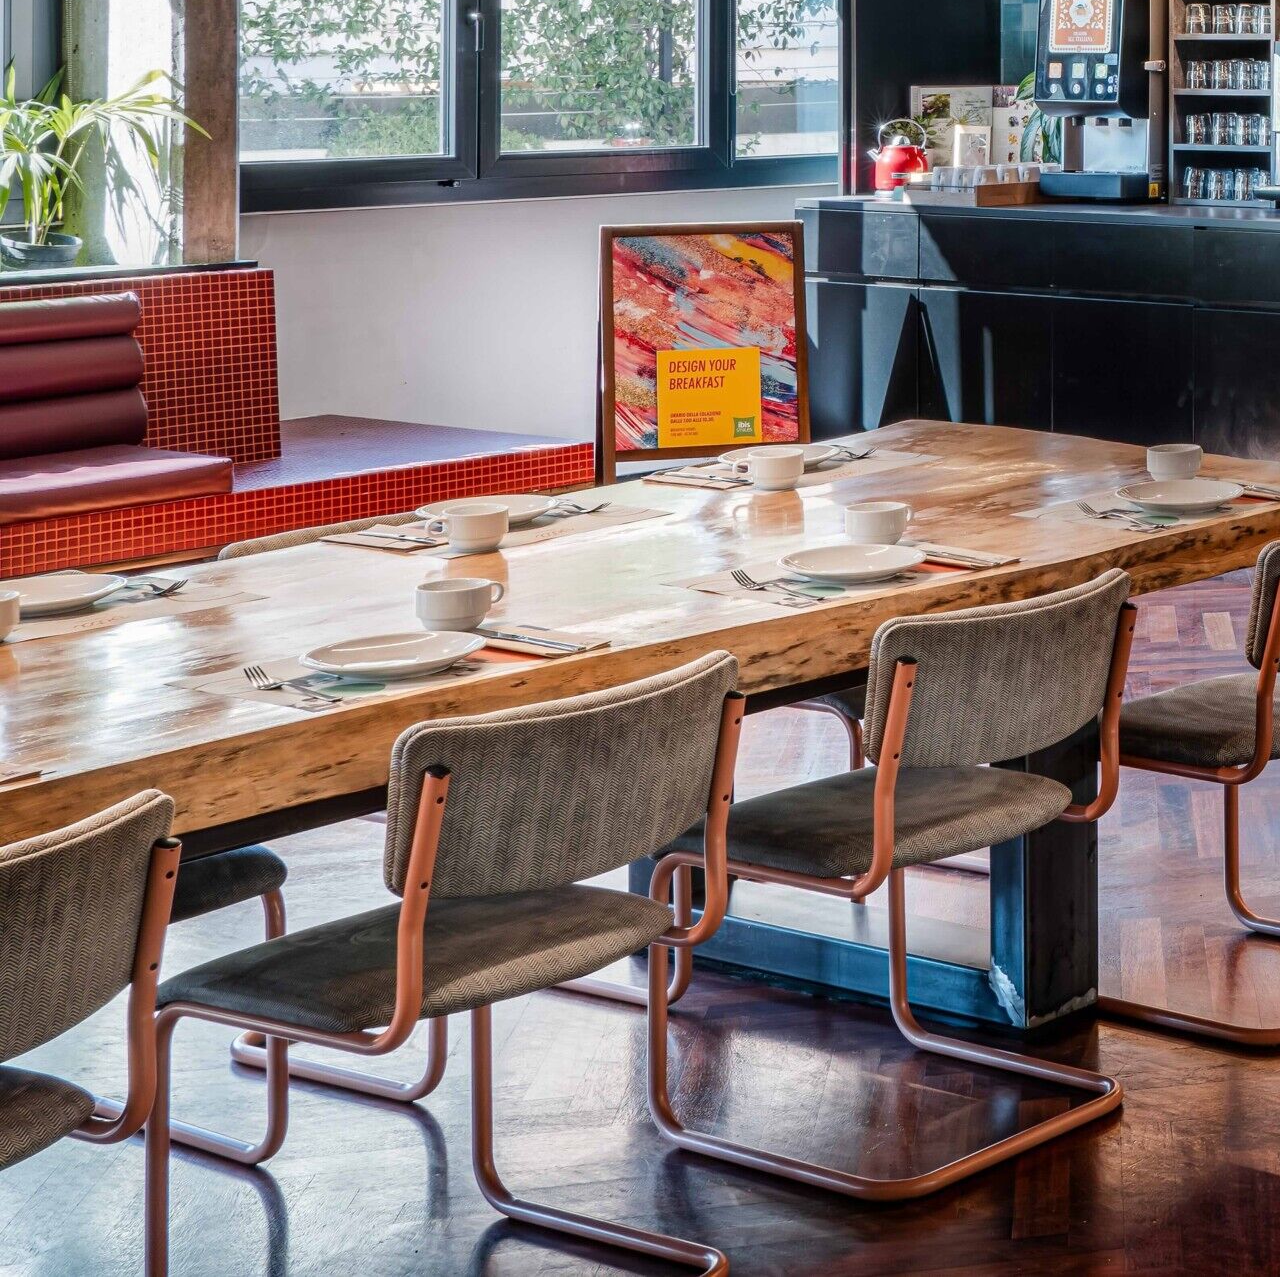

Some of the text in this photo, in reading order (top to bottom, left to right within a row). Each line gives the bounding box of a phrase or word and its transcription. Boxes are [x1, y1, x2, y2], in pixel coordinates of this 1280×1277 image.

[669, 358, 737, 374] DESIGN YOUR
[669, 375, 726, 391] BREAKFAST
